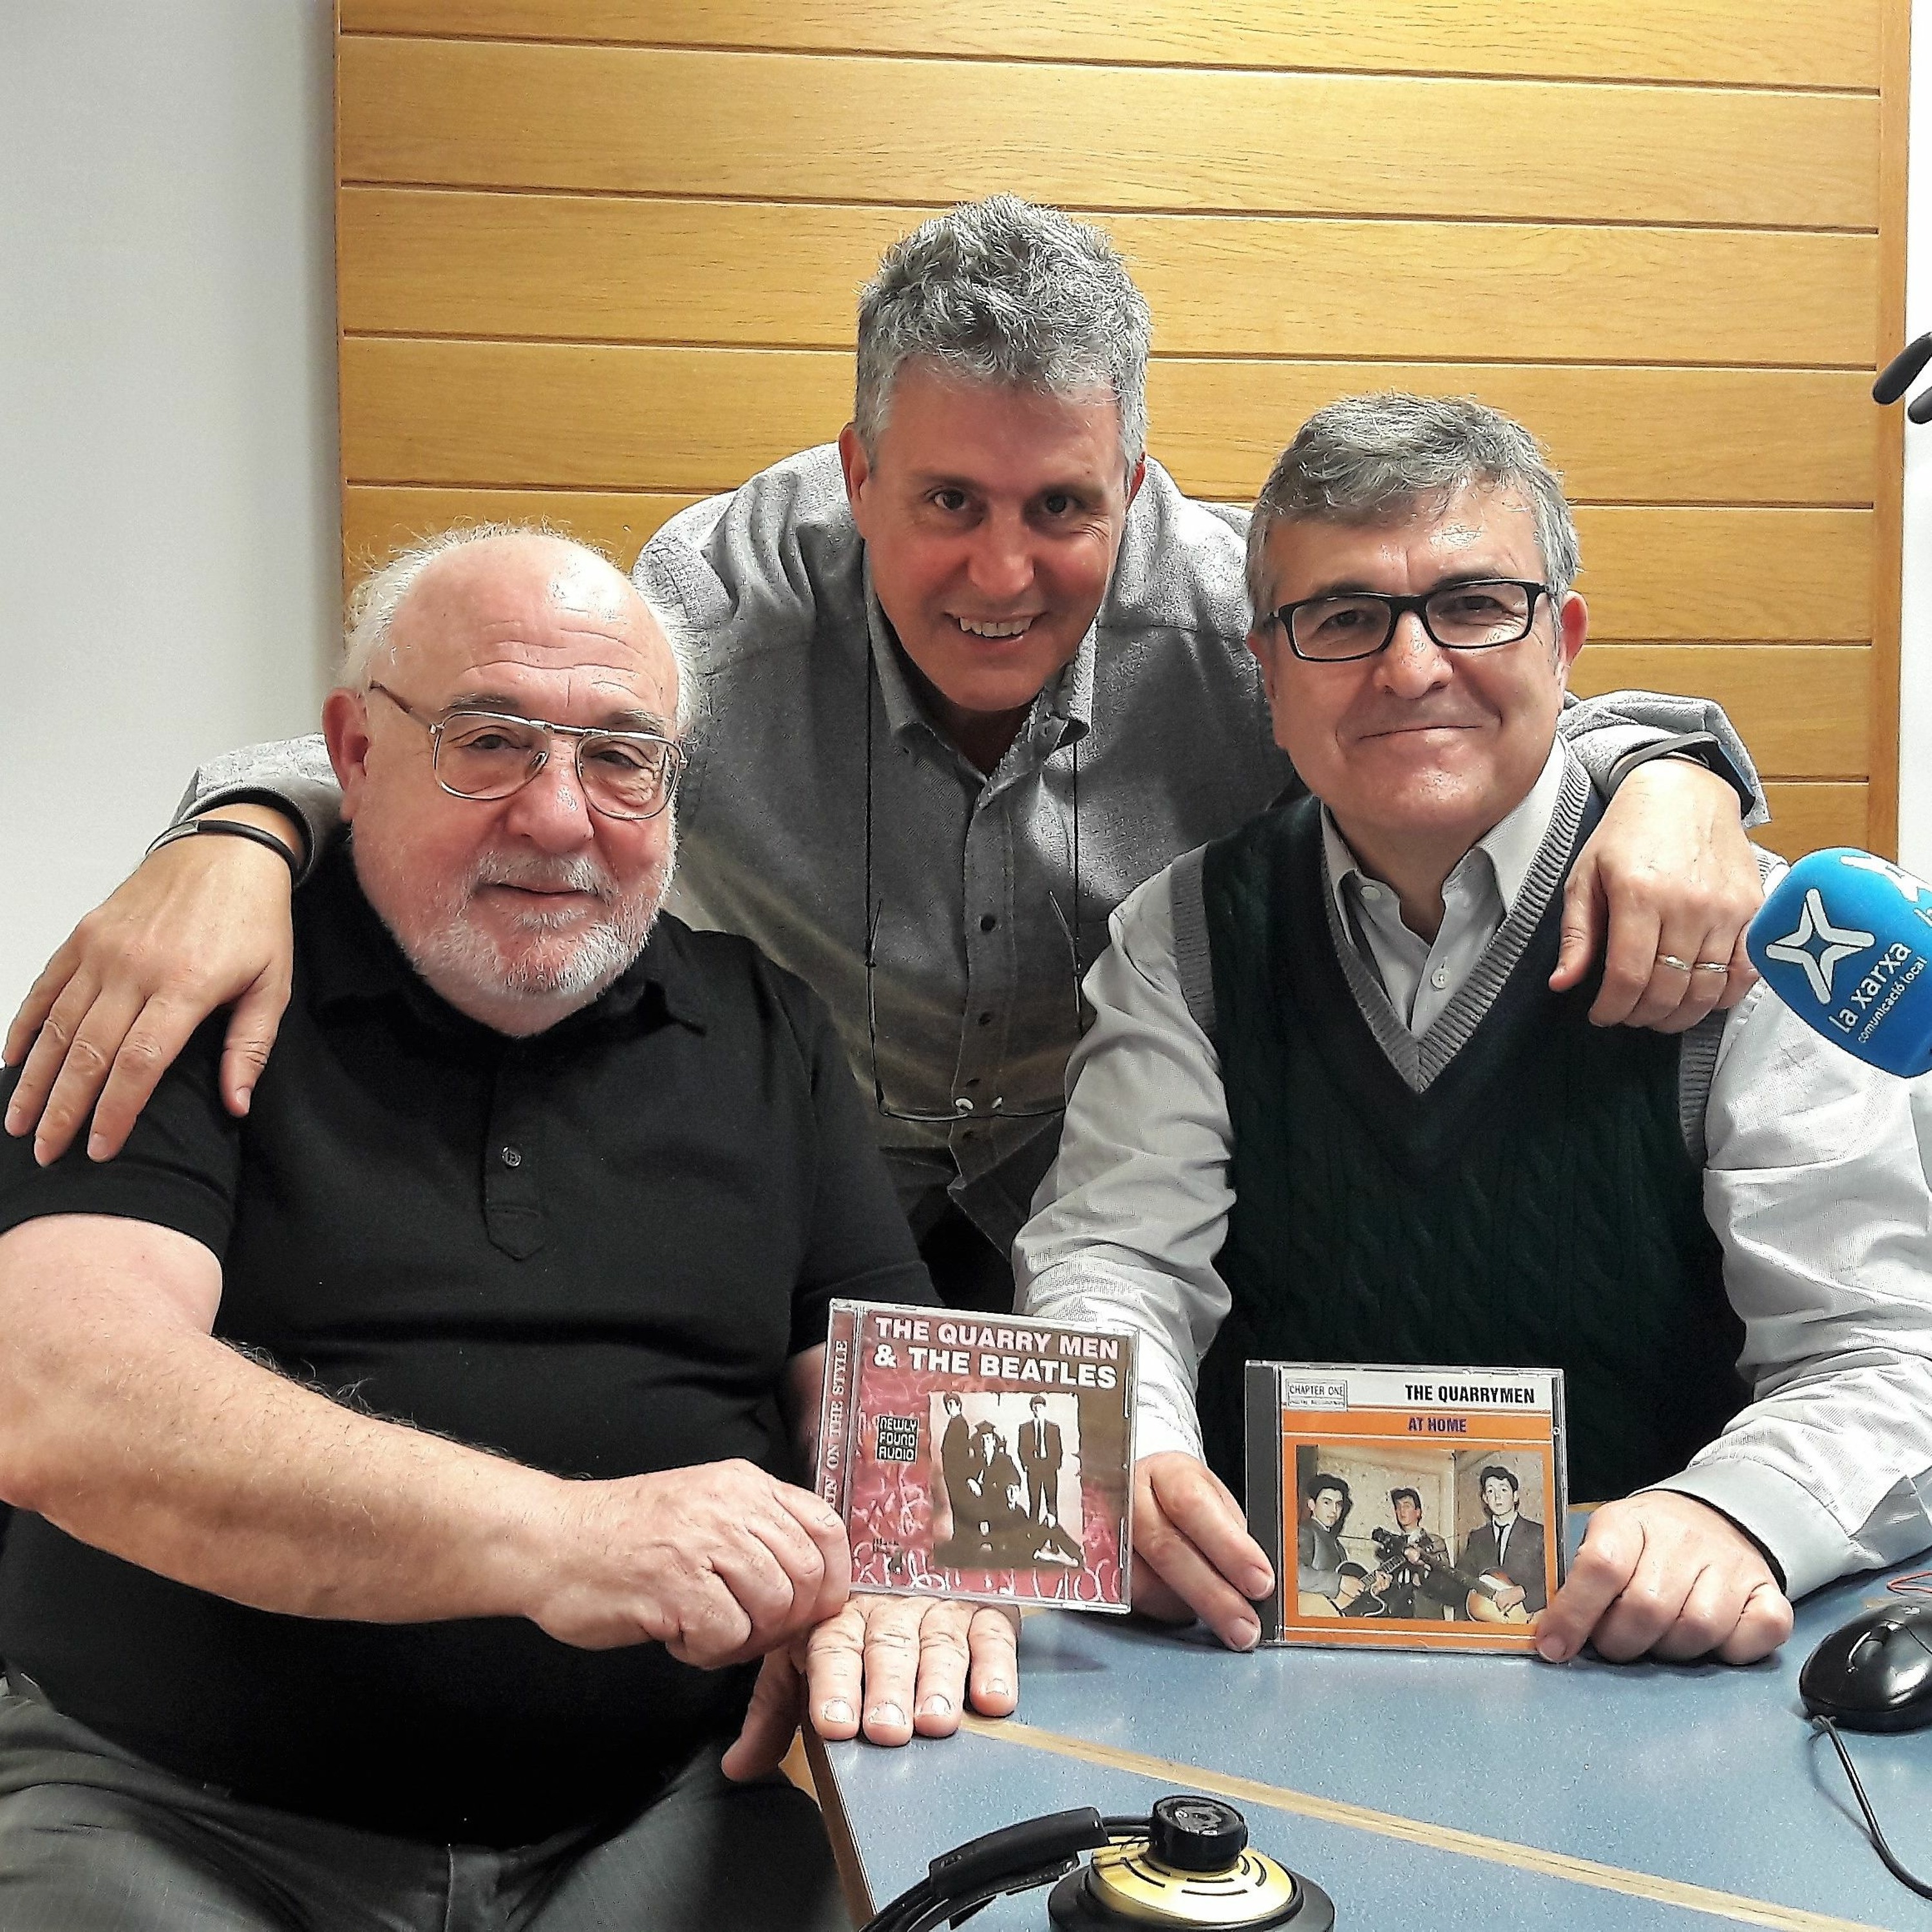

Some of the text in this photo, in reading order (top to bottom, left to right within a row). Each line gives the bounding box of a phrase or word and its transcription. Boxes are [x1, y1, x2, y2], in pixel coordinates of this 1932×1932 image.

[1899, 956, 1927, 984] local
[1828, 943, 1913, 1034] la xarxa
[875, 1316, 1119, 1360] THE QUARRY MEN
[831, 1340, 848, 1396] STYLE
[873, 1343, 1117, 1390] & THE BEATLES
[1289, 1384, 1344, 1396] CHAPTER ONE
[1405, 1385, 1535, 1404] THE QUARRYMEN
[829, 1401, 844, 1437] THE
[880, 1417, 917, 1432] NEWLY
[1408, 1417, 1467, 1433] AT HOME
[879, 1432, 915, 1447] FOUND
[826, 1443, 840, 1470] ON
[878, 1446, 914, 1461] AUDIO
